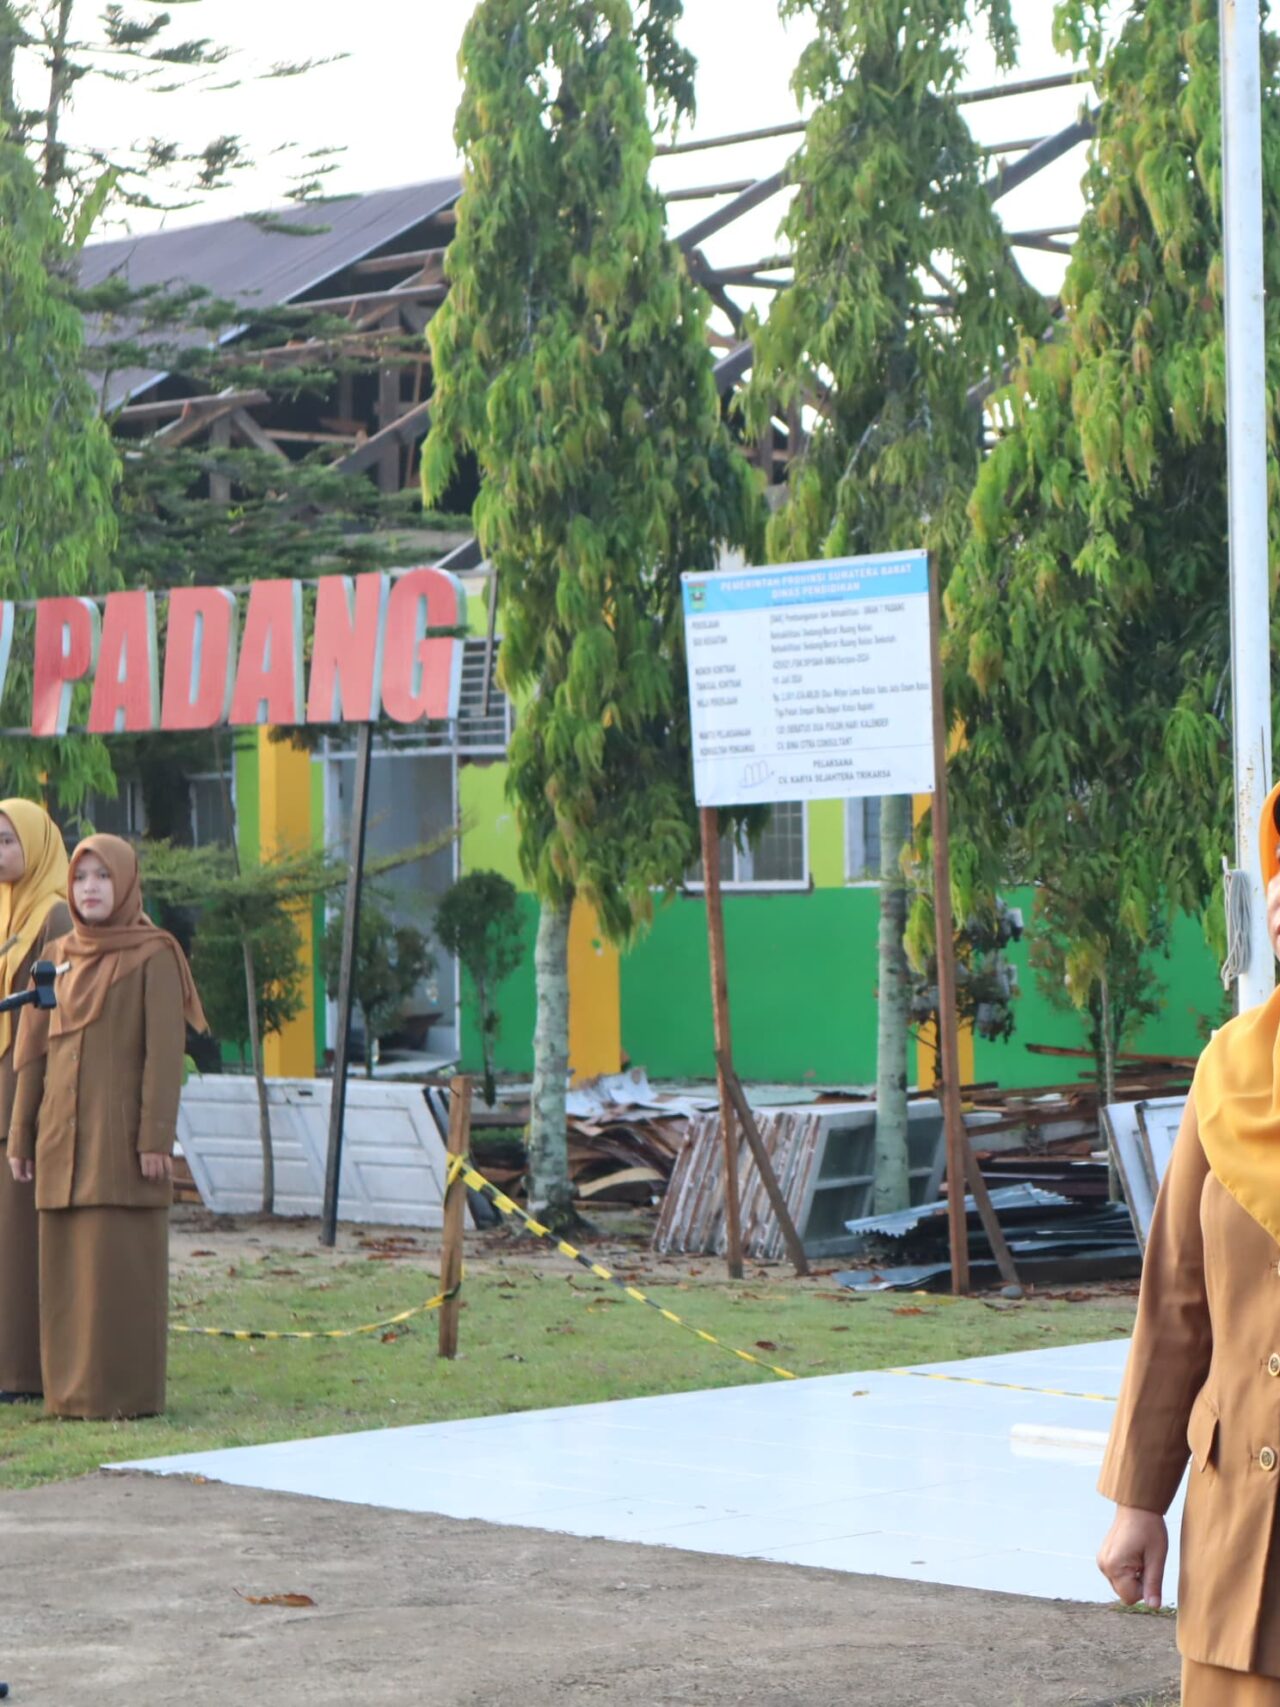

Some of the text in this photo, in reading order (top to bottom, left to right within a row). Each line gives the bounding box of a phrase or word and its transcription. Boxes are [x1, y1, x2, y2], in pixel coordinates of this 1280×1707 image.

[720, 563, 911, 591] PEMERINTAH PROVINSI SUMATERA BARAT
[771, 581, 859, 599] DINAS PENDIDIKAN
[32, 567, 468, 736] PADANG
